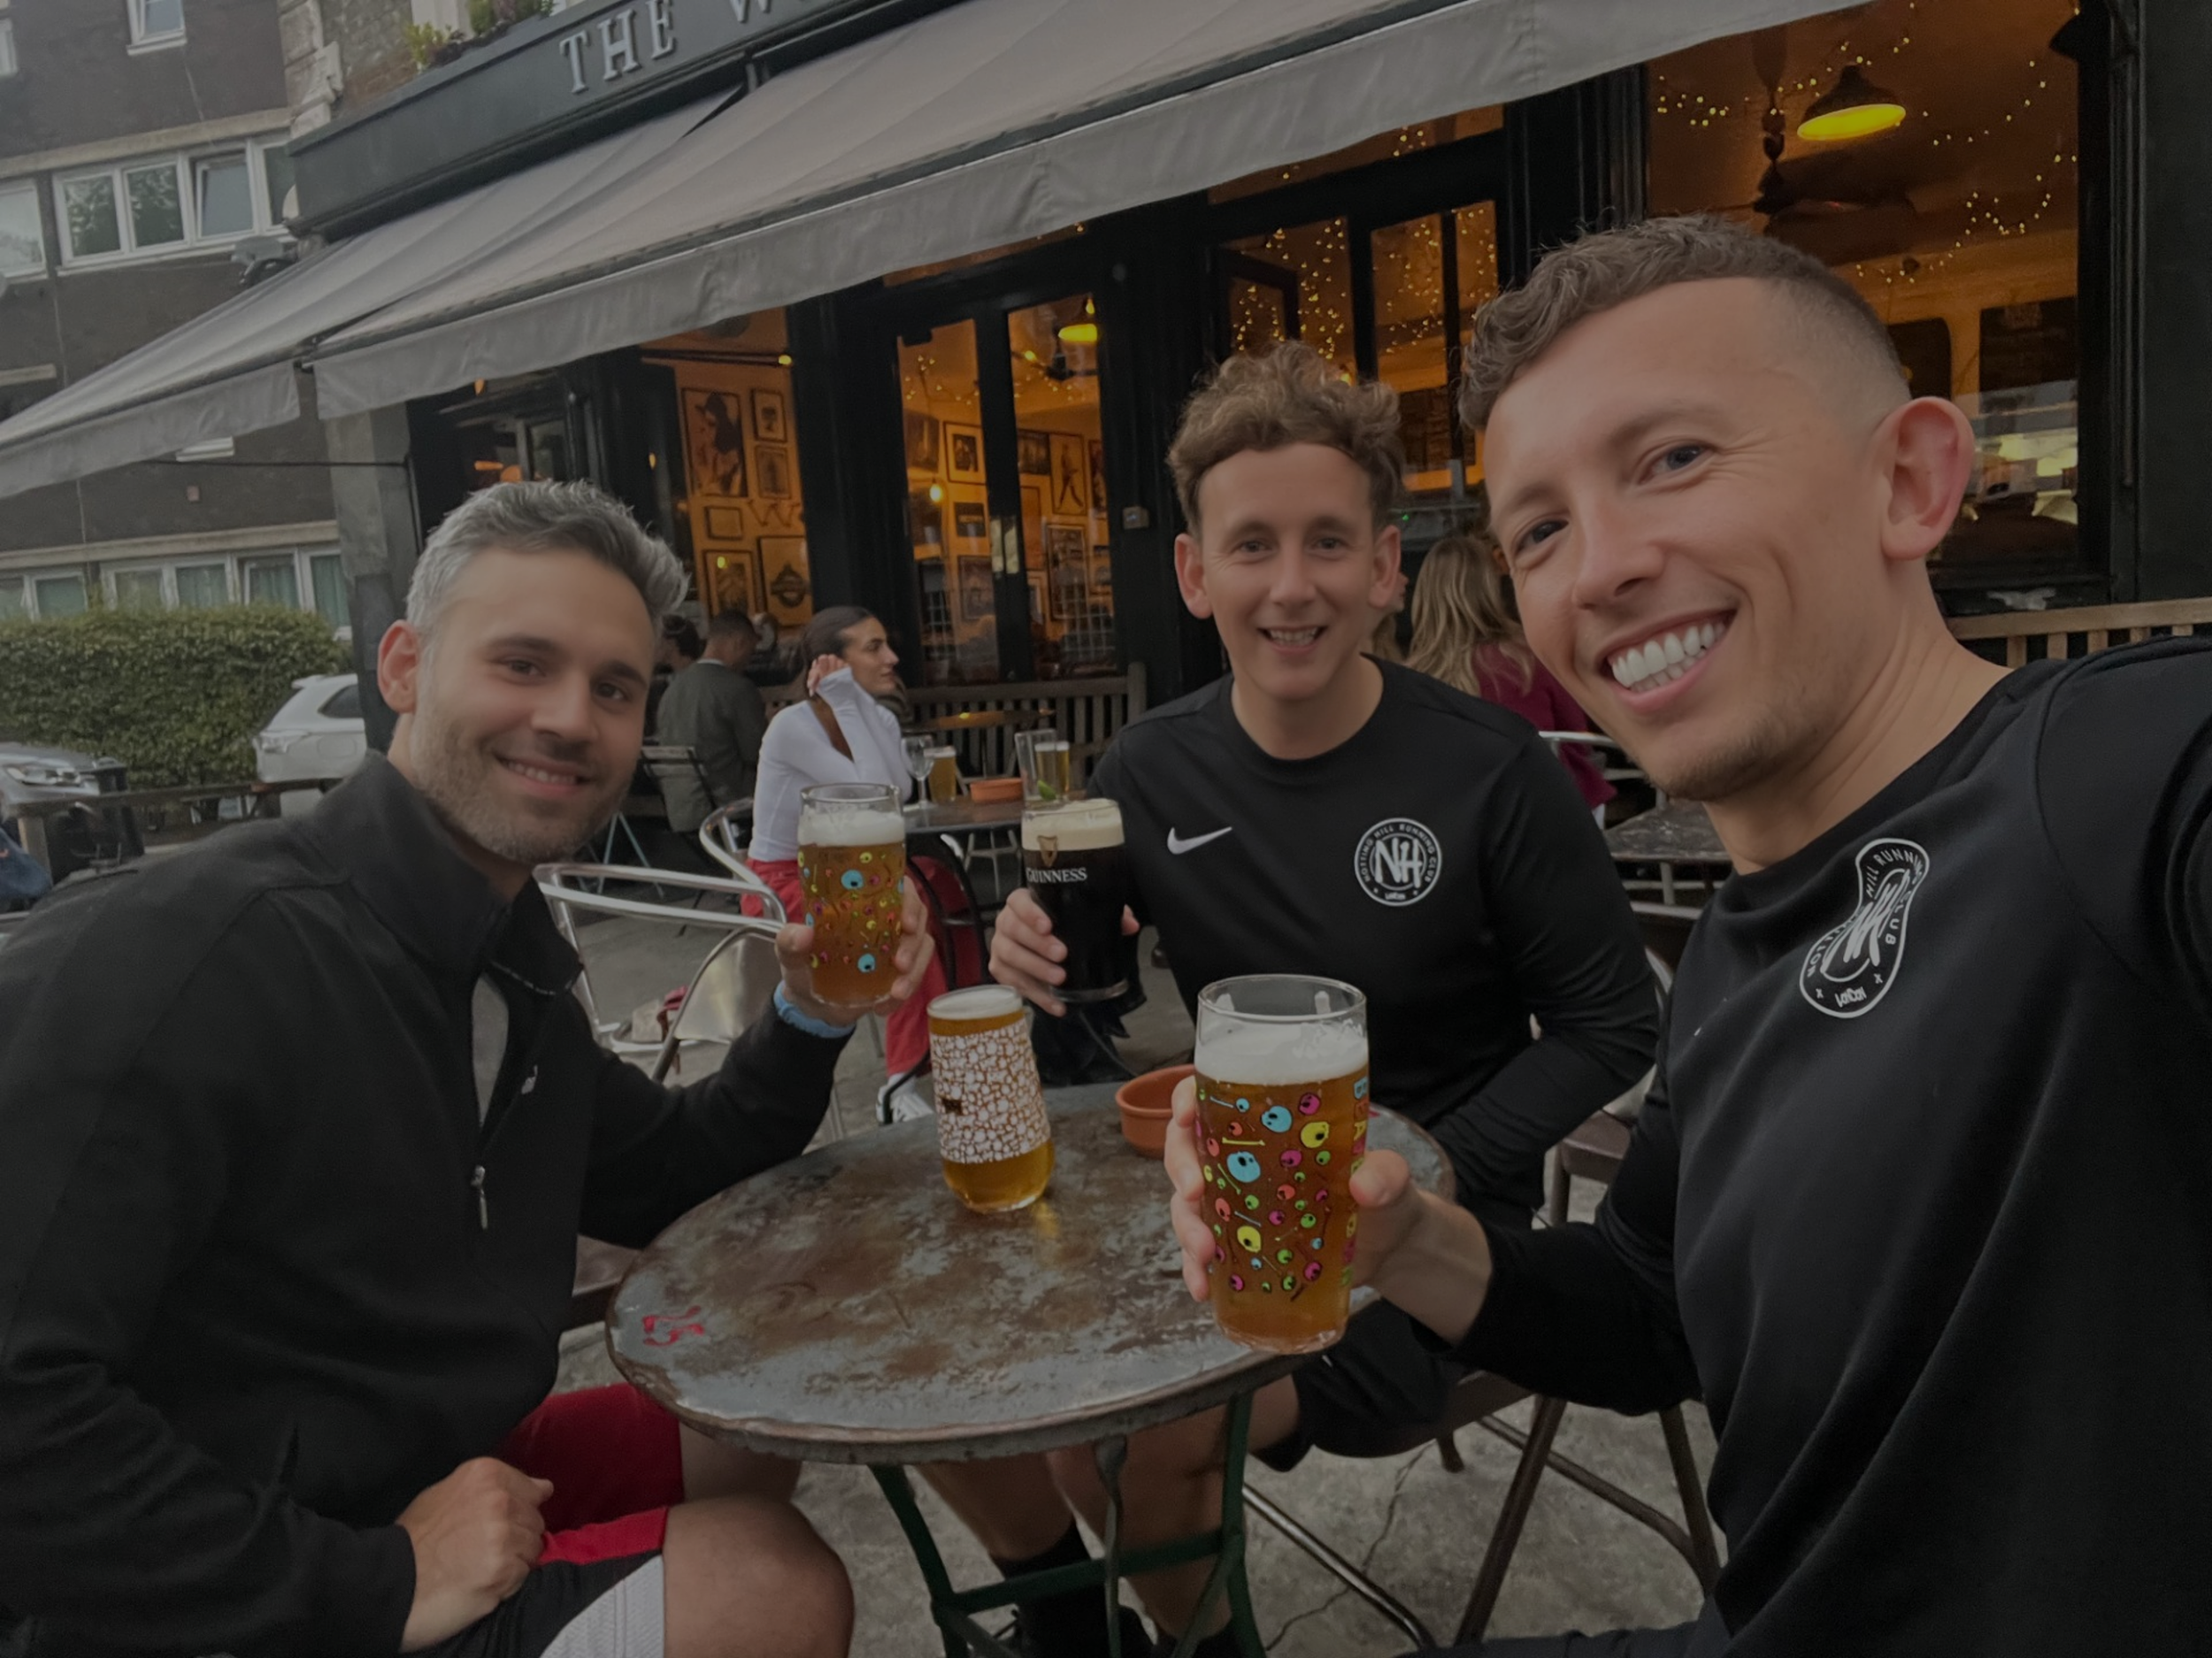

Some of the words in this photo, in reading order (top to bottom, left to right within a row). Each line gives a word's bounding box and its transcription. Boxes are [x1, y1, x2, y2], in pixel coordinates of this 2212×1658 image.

[559, 0, 678, 94] THE
[1026, 867, 1088, 883] GUINNESS
[1374, 836, 1423, 888] NH
[1865, 865, 1880, 898] HILL
